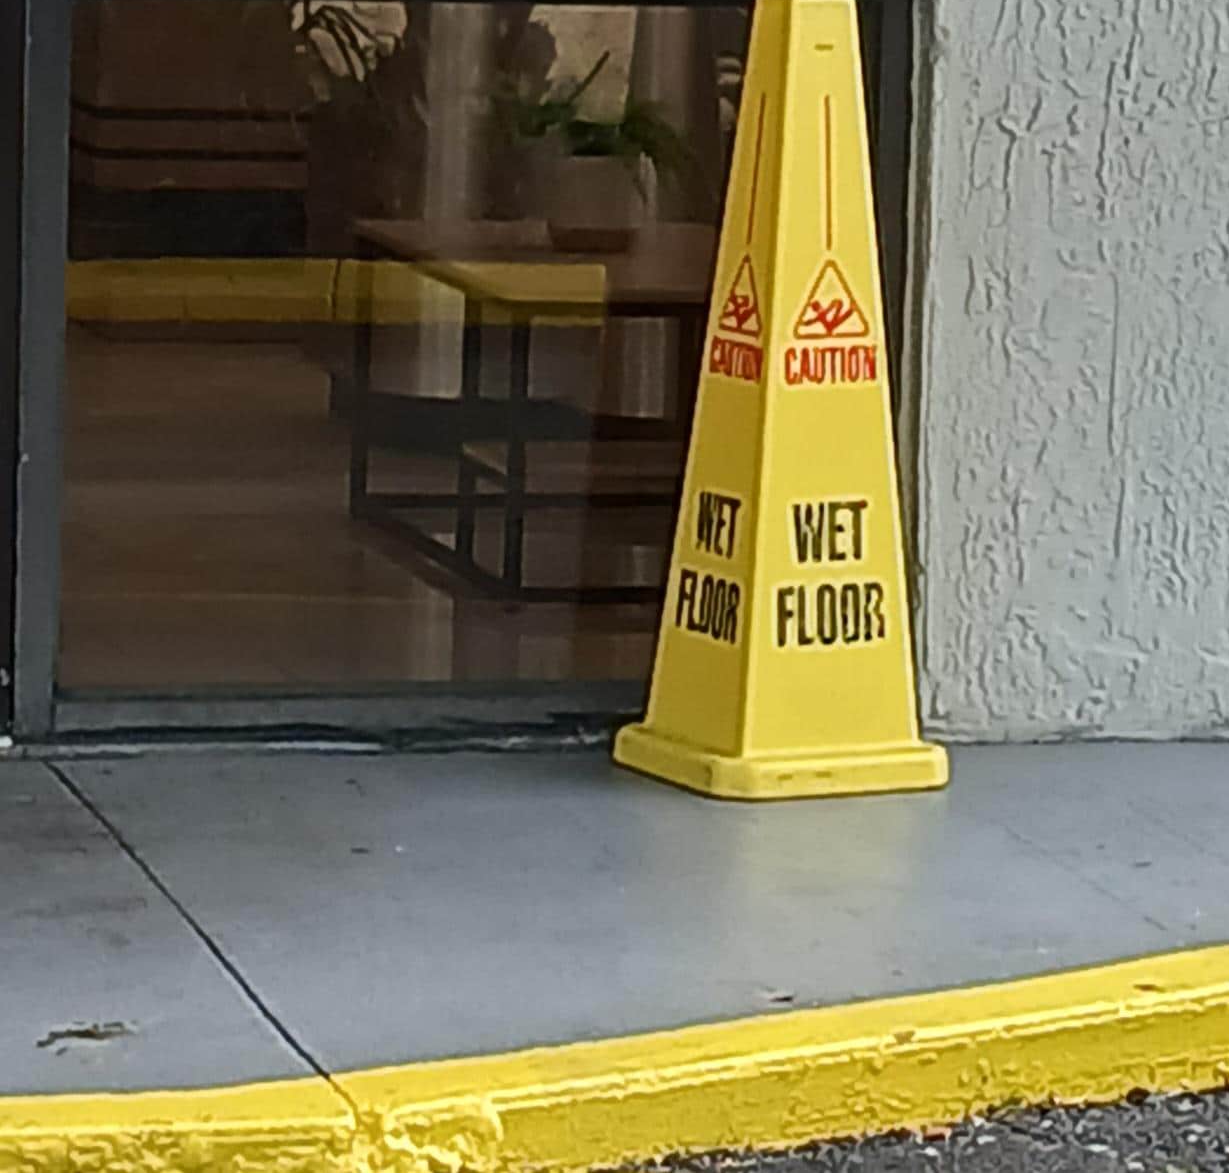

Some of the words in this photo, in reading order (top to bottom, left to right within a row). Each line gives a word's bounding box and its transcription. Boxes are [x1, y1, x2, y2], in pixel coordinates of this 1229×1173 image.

[784, 344, 877, 385] CAUTION
[696, 491, 741, 559] WET
[793, 500, 868, 563] WET
[675, 568, 741, 645] FLOOR
[776, 582, 885, 648] FLOOR
